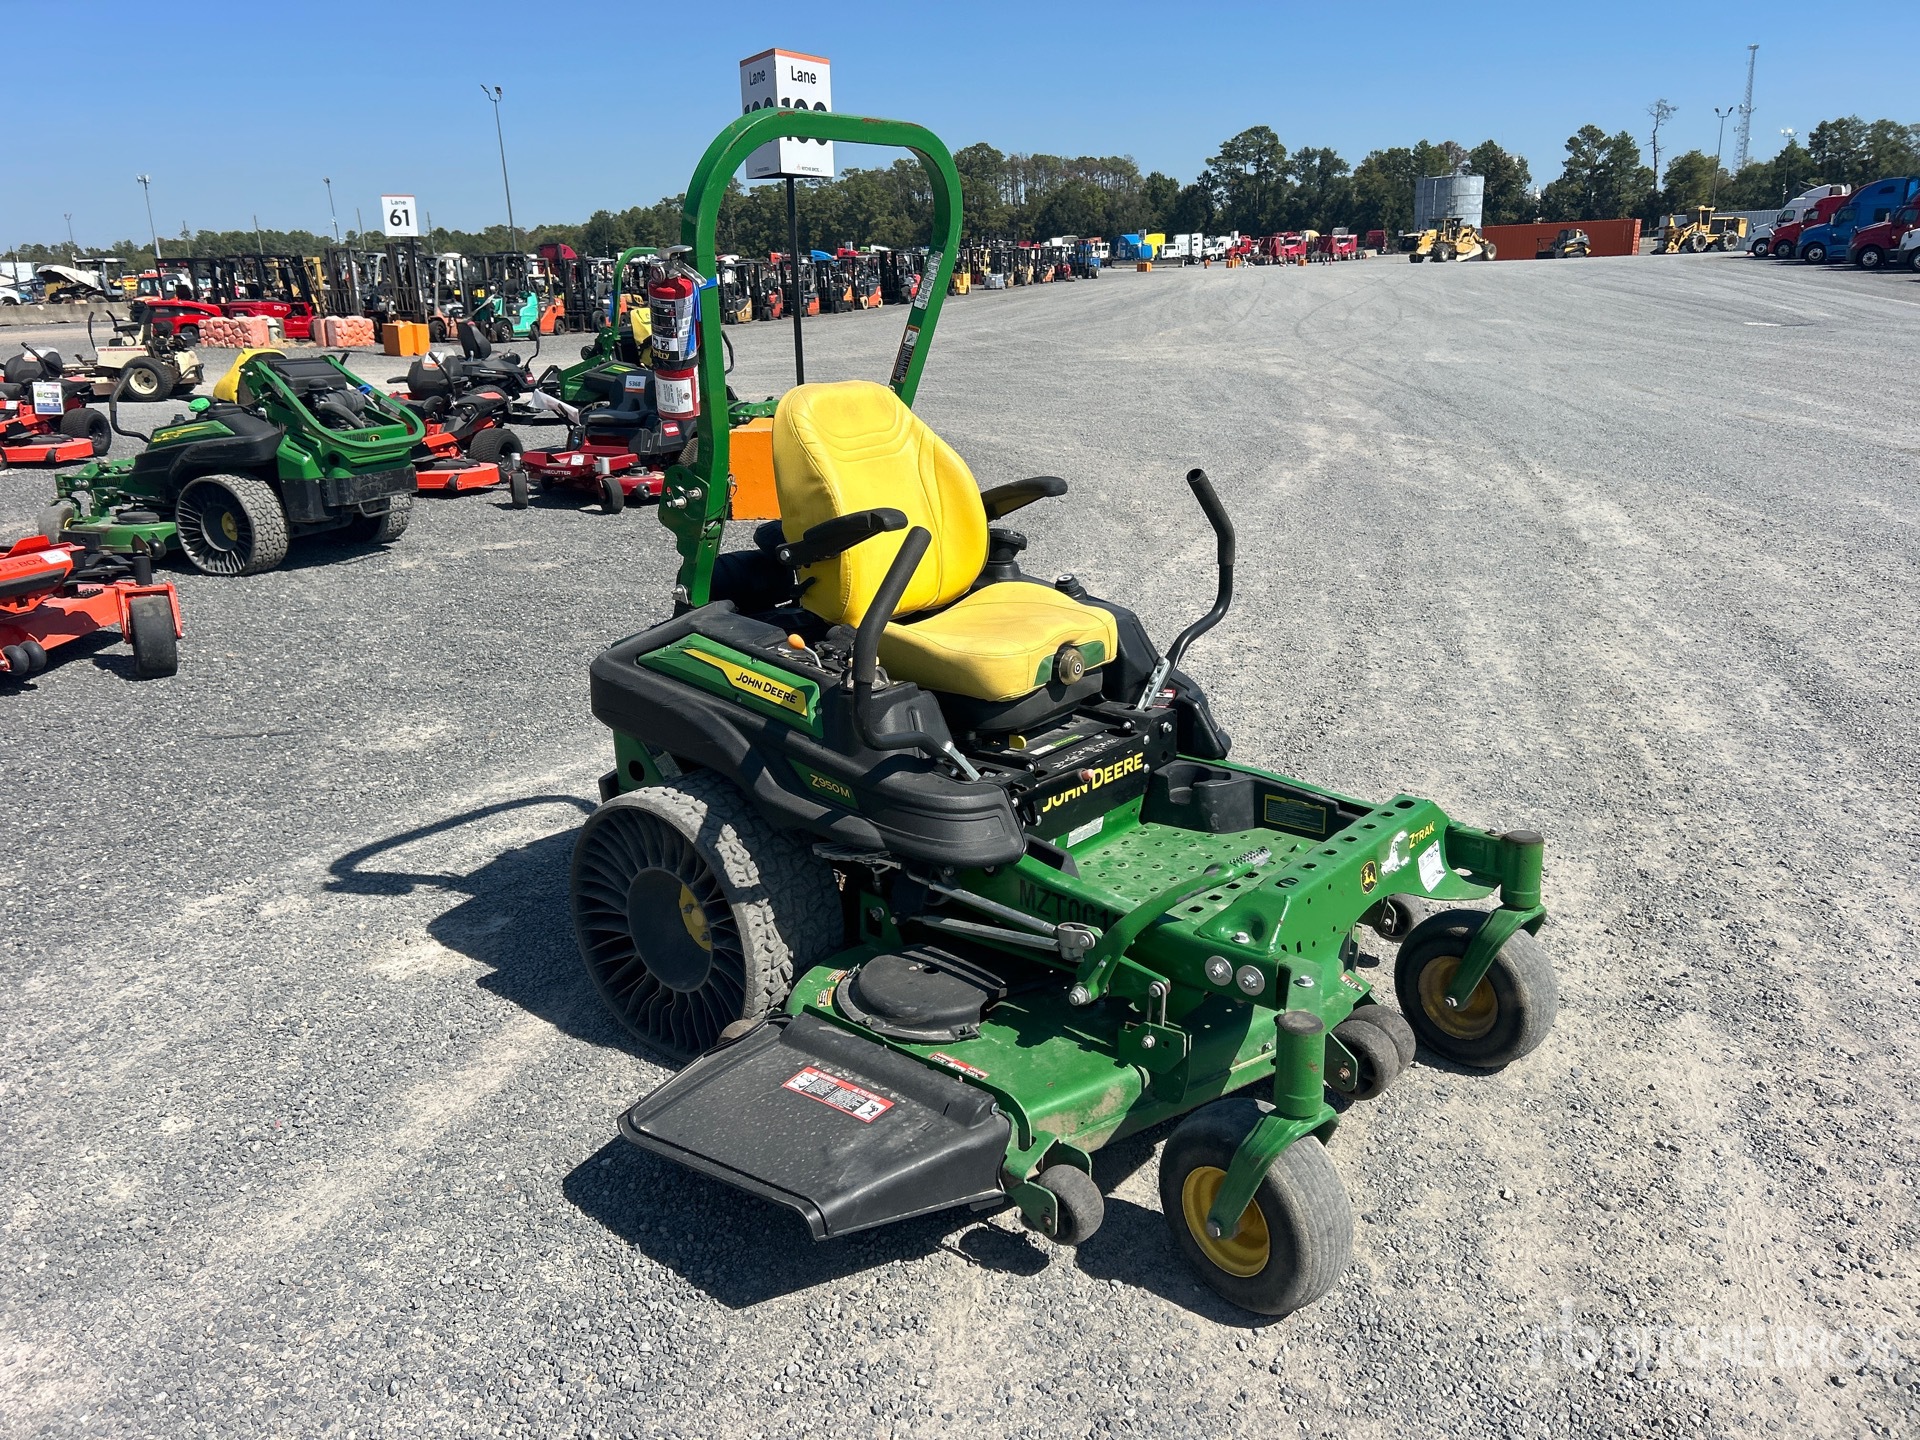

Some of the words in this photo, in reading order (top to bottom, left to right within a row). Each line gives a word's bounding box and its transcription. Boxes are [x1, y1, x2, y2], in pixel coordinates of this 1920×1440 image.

[749, 70, 766, 85] Lane
[791, 66, 816, 84] Lane
[389, 208, 410, 227] 61
[735, 671, 763, 690] JOHN
[762, 682, 798, 705] DEERE
[1091, 751, 1144, 790] DEERE
[809, 773, 851, 799] Z950M
[1409, 820, 1435, 850] ZTRAK
